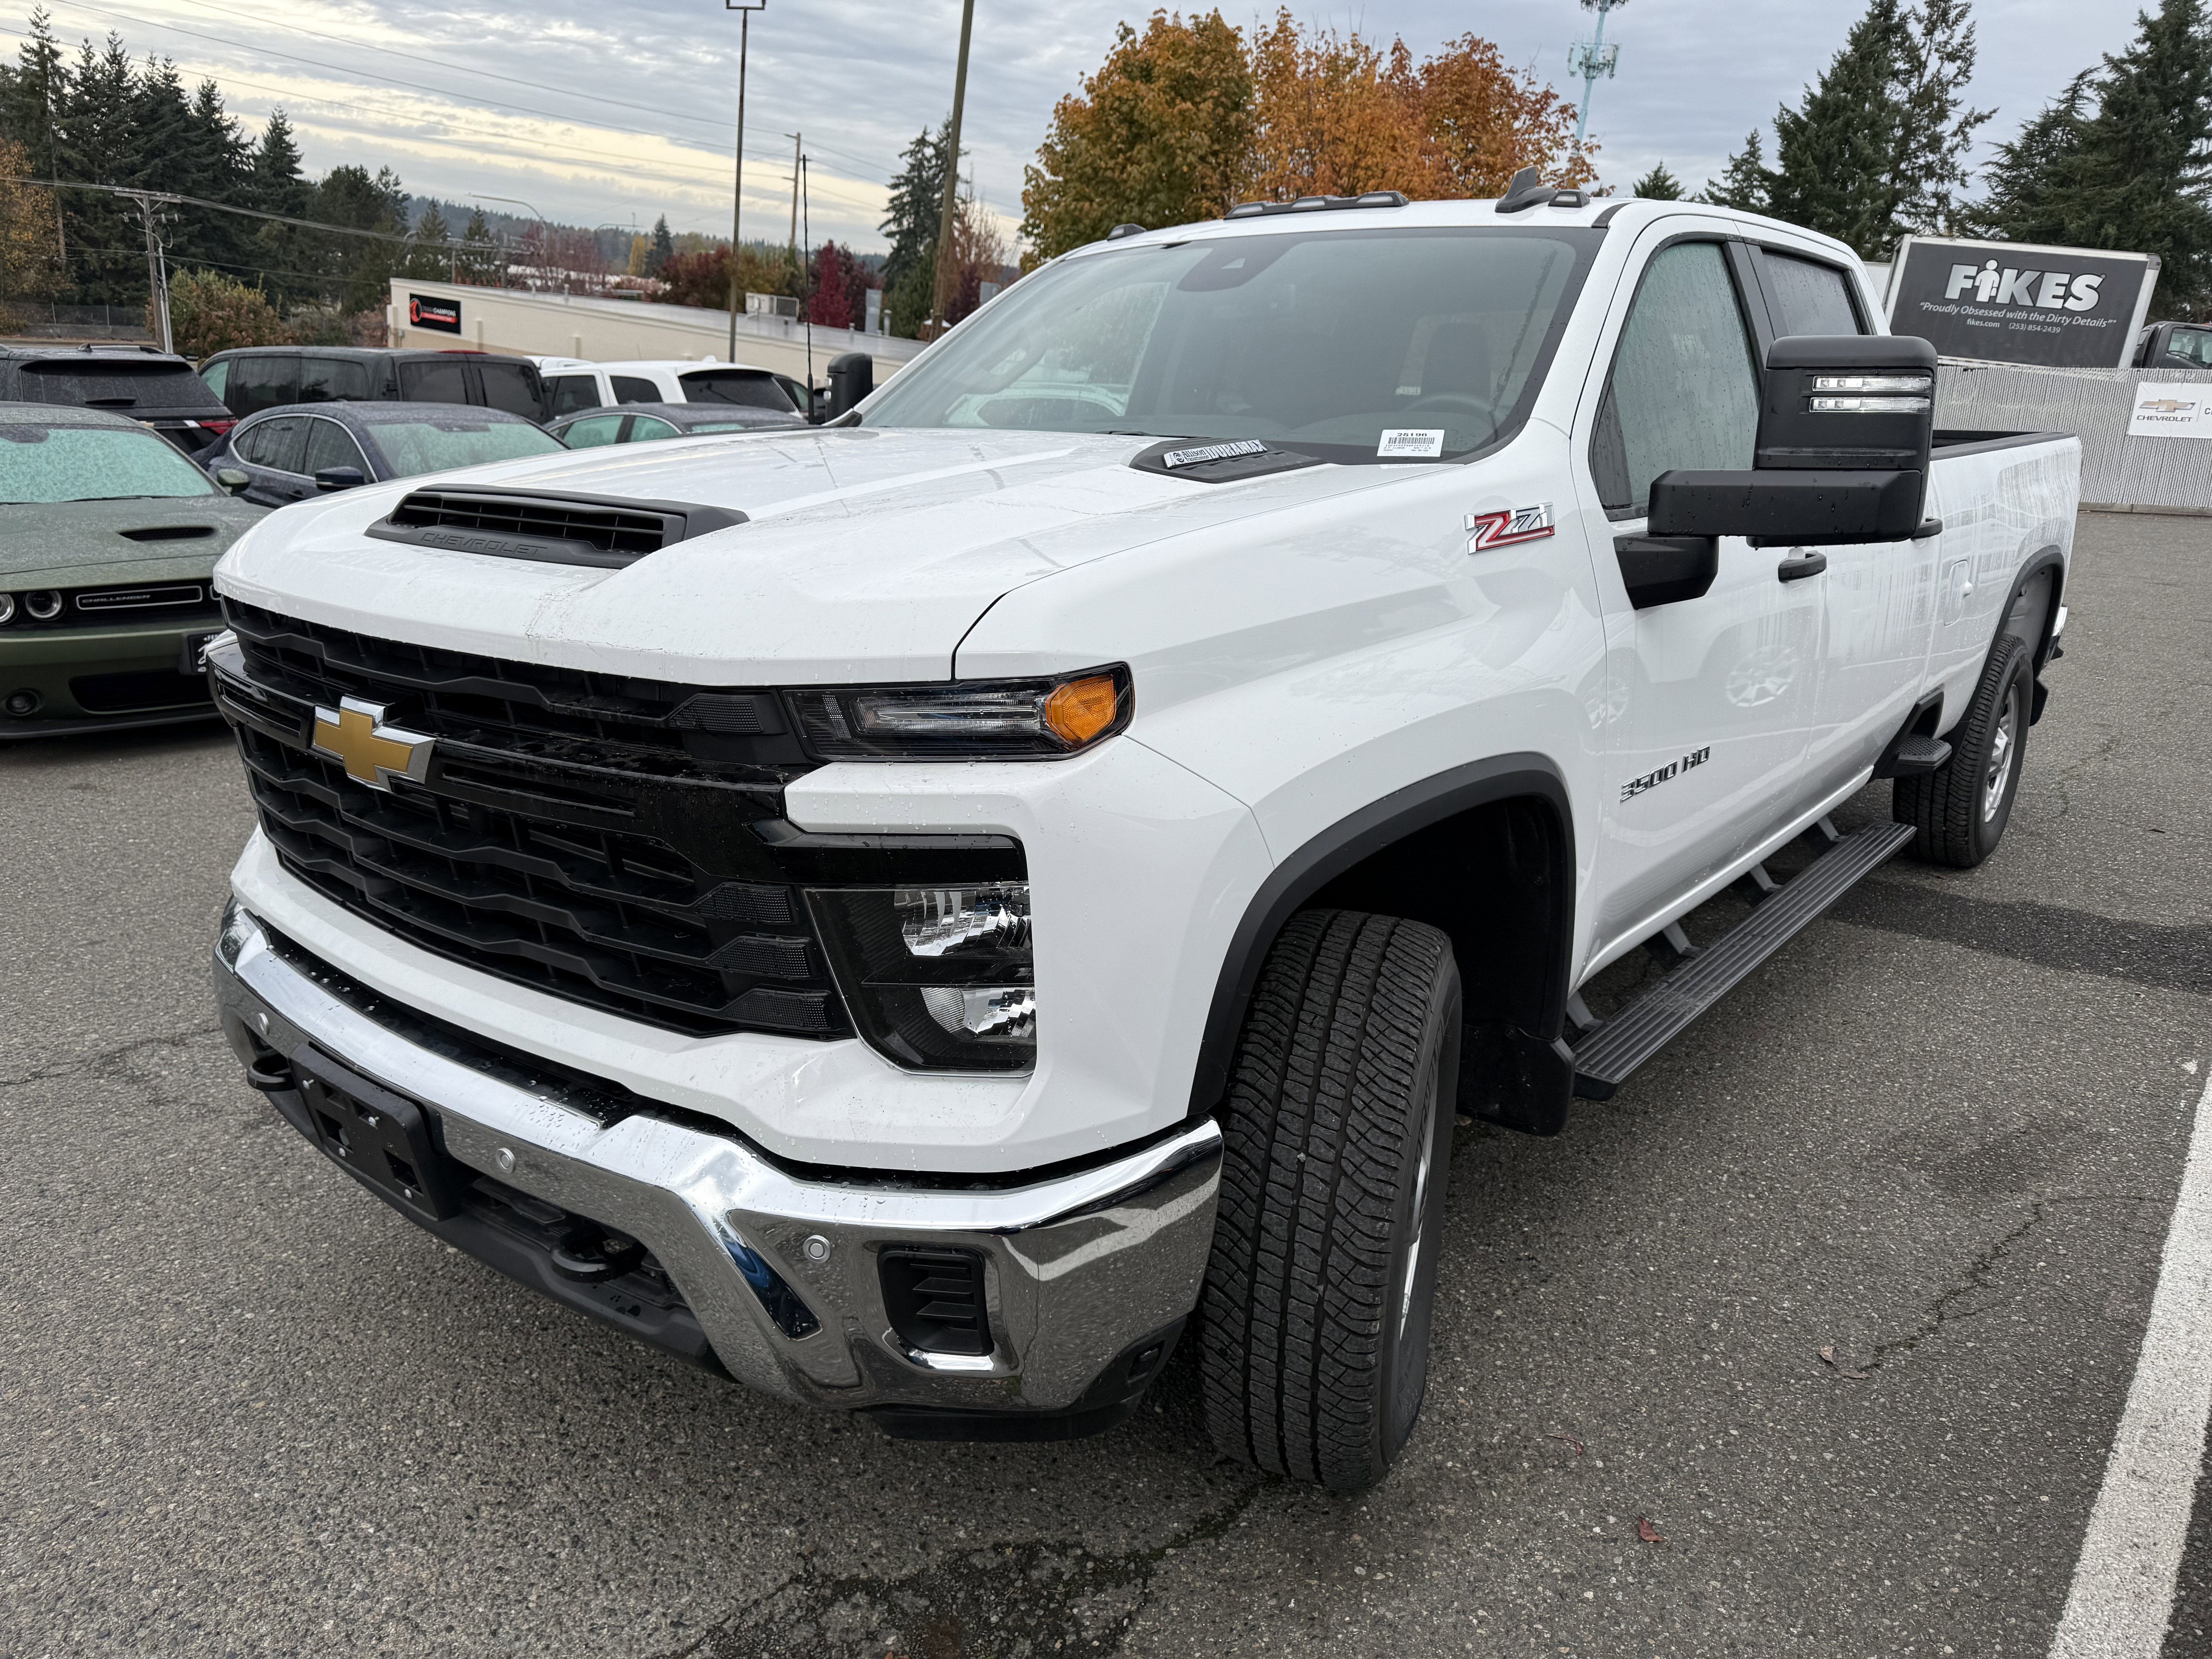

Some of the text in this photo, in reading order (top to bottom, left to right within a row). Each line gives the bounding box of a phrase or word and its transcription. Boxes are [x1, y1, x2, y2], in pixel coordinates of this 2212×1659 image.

[1961, 306, 2006, 318] Obsessed
[2007, 311, 2027, 320] with
[2029, 312, 2045, 321] the
[2046, 313, 2072, 326] Dirty
[1967, 318, 2061, 333] fikes.com (253) 854-2439
[1182, 449, 1206, 460] Allison
[1205, 439, 1268, 459] DURAMAX
[1464, 502, 1555, 555] Z71
[421, 533, 548, 555] CHEVROLET
[1620, 744, 1710, 803] 3500 HD
